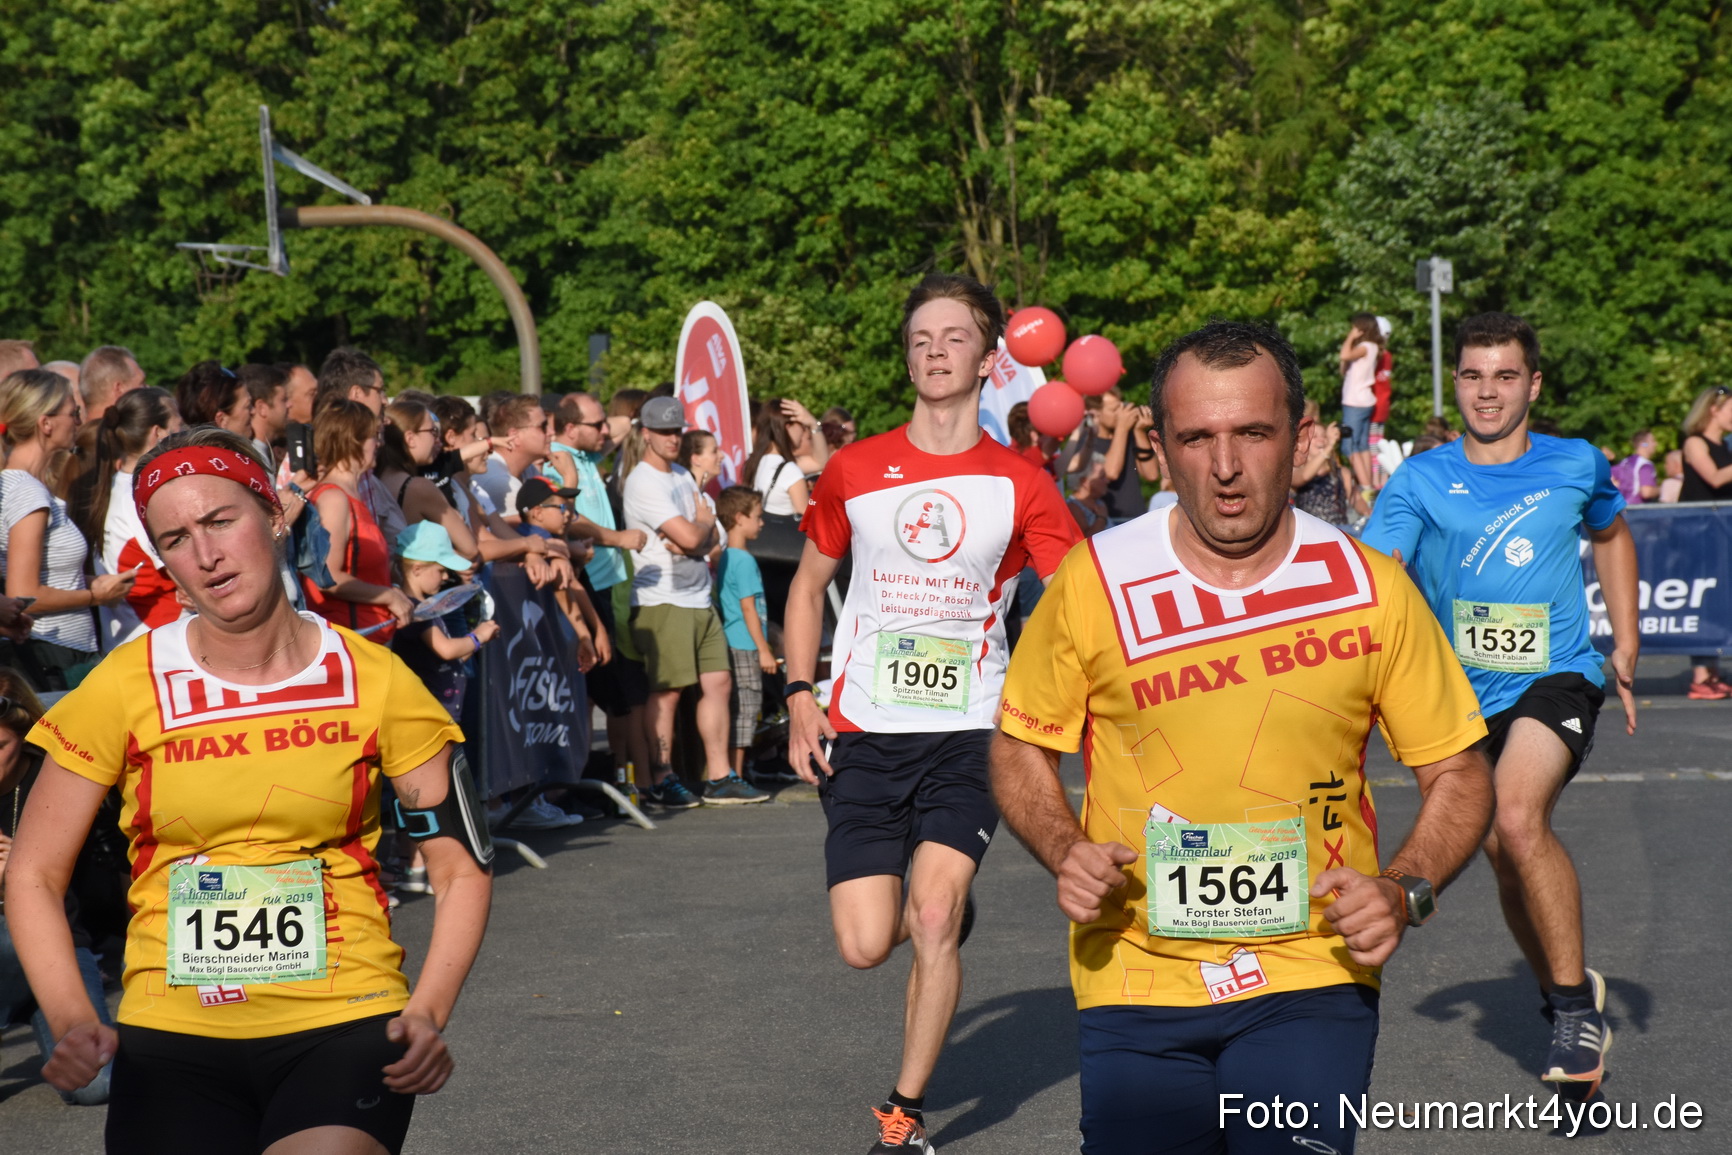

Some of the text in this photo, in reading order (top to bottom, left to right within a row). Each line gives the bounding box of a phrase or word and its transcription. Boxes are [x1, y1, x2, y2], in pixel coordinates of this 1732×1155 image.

[1460, 488, 1551, 568] Team Schick Bau
[954, 576, 981, 592] HER
[881, 590, 894, 599] Dr.
[896, 591, 920, 601] Heck
[921, 592, 927, 602] /
[929, 594, 942, 603] Dr.
[881, 603, 972, 619] Leistungsdiagnostik
[1465, 626, 1536, 653] 1532
[948, 658, 966, 666] 2019
[1473, 651, 1528, 661] Schmitt Fabian
[1130, 625, 1382, 711] MAX BÖGL
[887, 659, 958, 691] 1905
[892, 685, 949, 698] Spitzner Tilman
[38, 716, 95, 763] ax-boegl.de
[164, 718, 359, 764] MAX BÖGL
[1170, 845, 1233, 857] firmenlauf
[1270, 849, 1298, 862] 2019
[1168, 862, 1289, 905] 1564
[188, 887, 248, 900] firmenlauf
[285, 892, 313, 904] 2019
[1186, 906, 1272, 918] Forster Stefan
[186, 905, 304, 951] 1546
[1172, 916, 1285, 929] Max Bögl Bauservice GmbH
[182, 950, 309, 964] Bierschneider Marina
[189, 962, 301, 975] Max Bögl Bauservice GmbH
